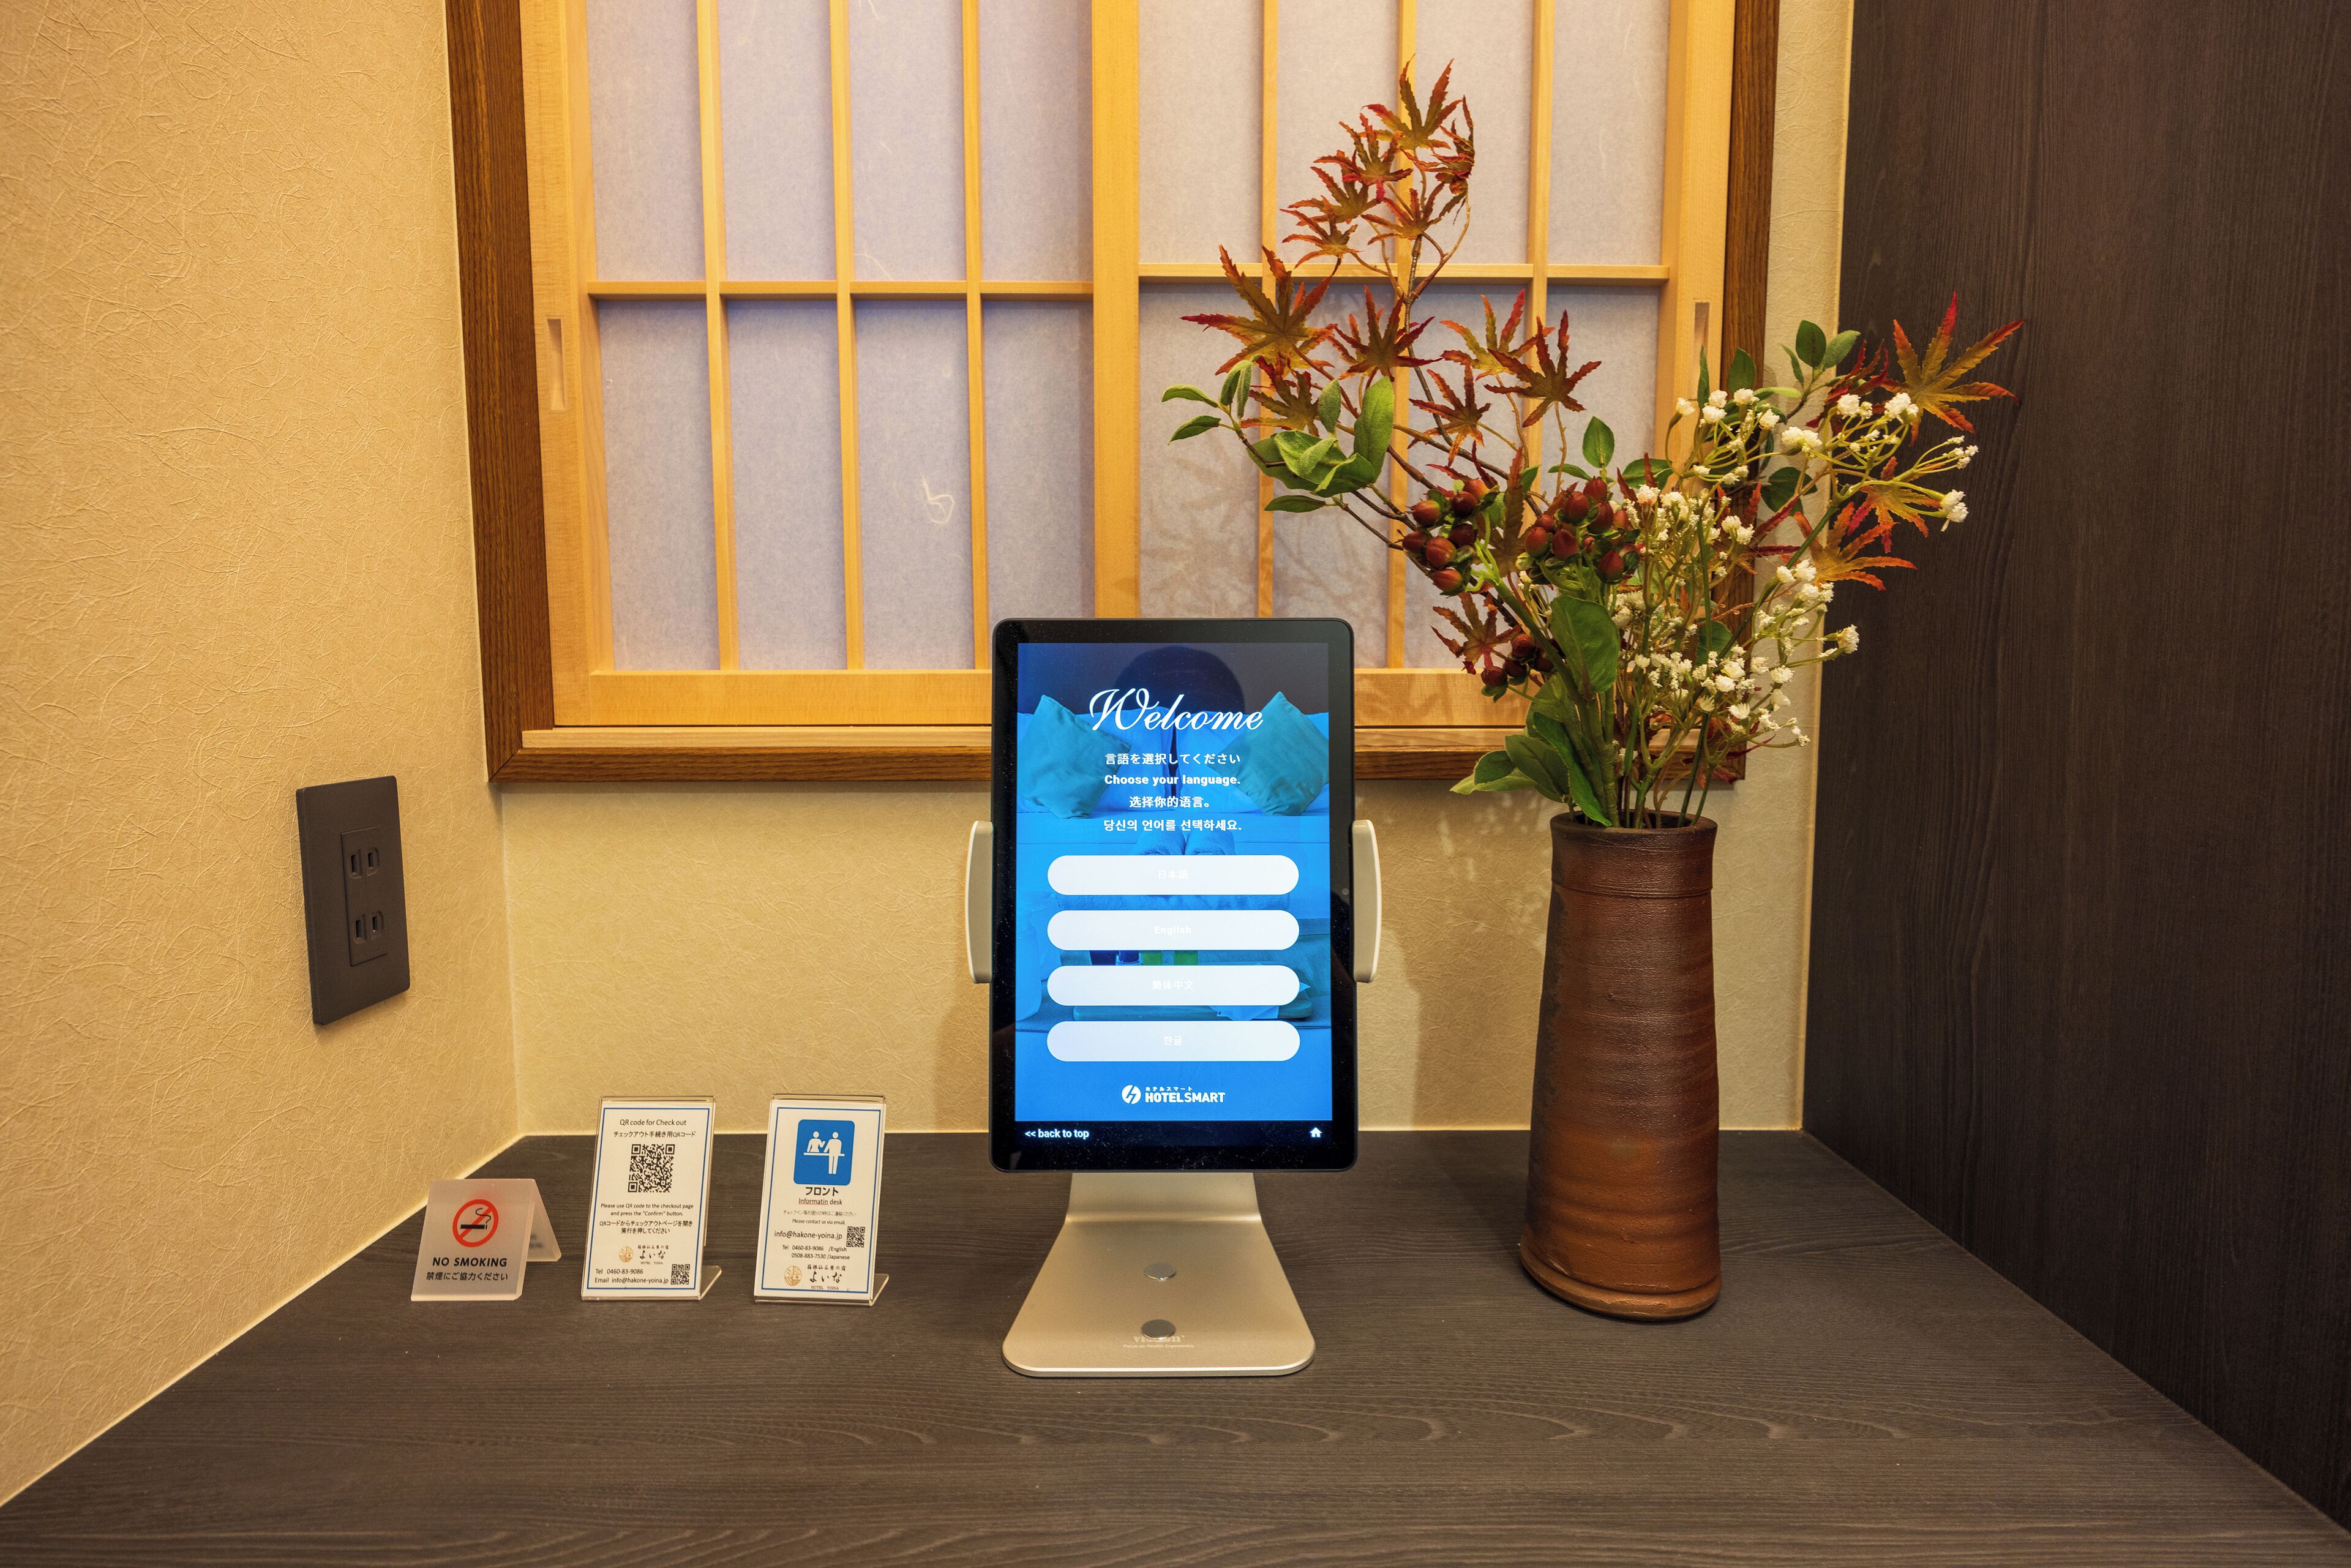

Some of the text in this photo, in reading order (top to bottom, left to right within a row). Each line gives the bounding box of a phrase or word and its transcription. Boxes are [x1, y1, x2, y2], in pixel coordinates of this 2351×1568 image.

[1089, 688, 1264, 731] Welcome
[1104, 753, 1241, 765] 言語を選択してください
[1104, 775, 1241, 787] Choose your language.
[1129, 796, 1210, 808] 选择你的语言。
[1103, 819, 1242, 831] 당신의 언어를 선택하세요.
[1158, 869, 1188, 880] 日本語
[1154, 925, 1191, 936] English
[1163, 1035, 1183, 1046] 한글
[1038, 1128, 1061, 1138] back
[1062, 1129, 1072, 1138] to
[1073, 1129, 1089, 1140] top
[805, 1187, 839, 1196] フロント
[774, 1230, 842, 1240] info@hakone-yoina.jp
[639, 1250, 666, 1259] よいな
[432, 1257, 507, 1267] NO SMOKING
[426, 1272, 508, 1281] 禁煙にご協力ください
[809, 1271, 842, 1283] よいな
